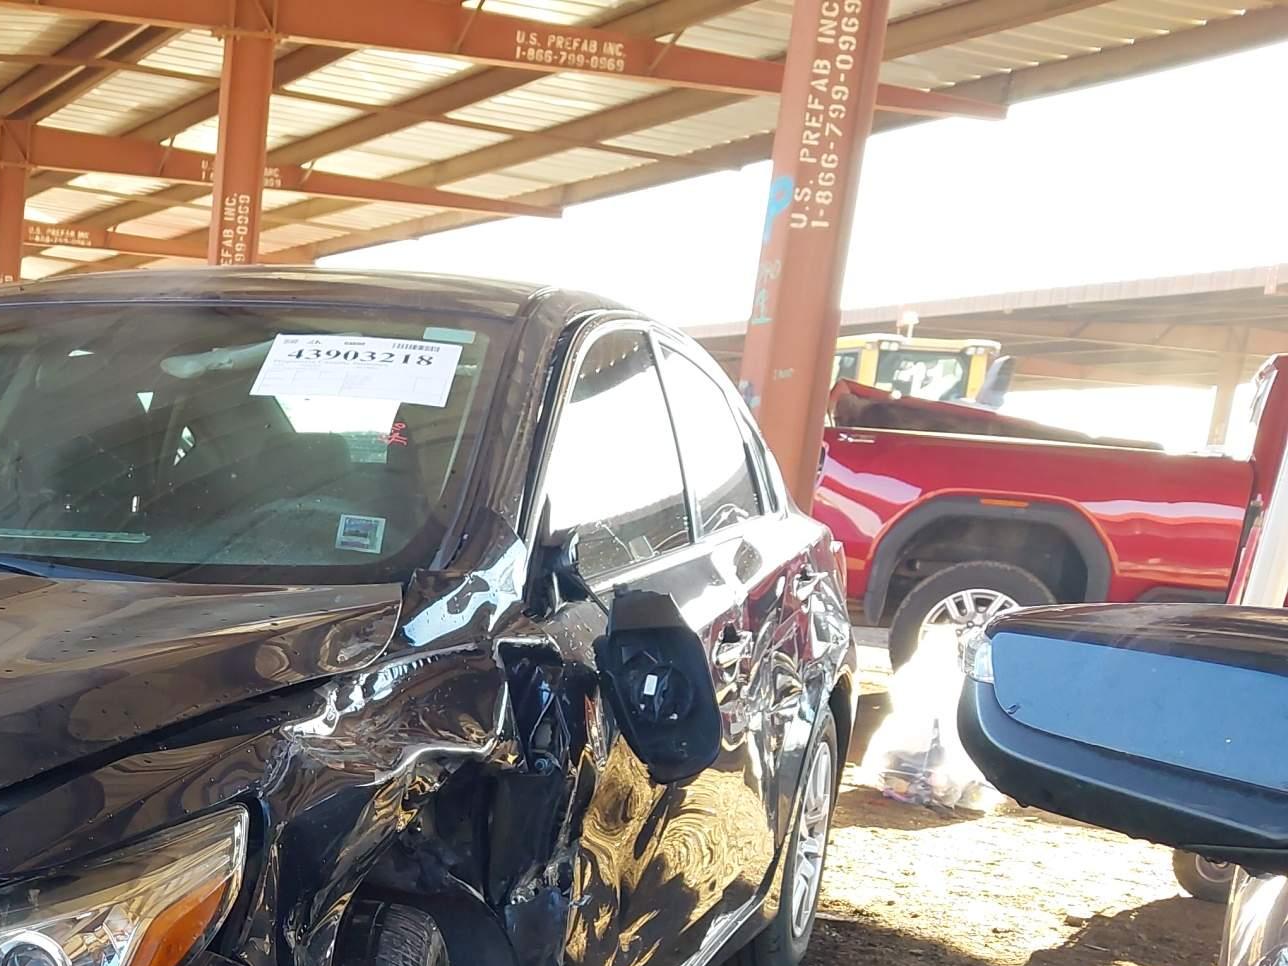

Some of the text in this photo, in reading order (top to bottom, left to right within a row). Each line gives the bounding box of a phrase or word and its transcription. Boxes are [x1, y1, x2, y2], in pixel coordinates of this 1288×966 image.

[516, 29, 541, 47] U.S.
[547, 34, 598, 54] PREFAB
[799, 58, 832, 164] PREFAB
[223, 192, 237, 221] INC.
[789, 178, 815, 229] U.S.
[234, 194, 250, 262] 99-0969
[288, 347, 434, 367] 43903218
